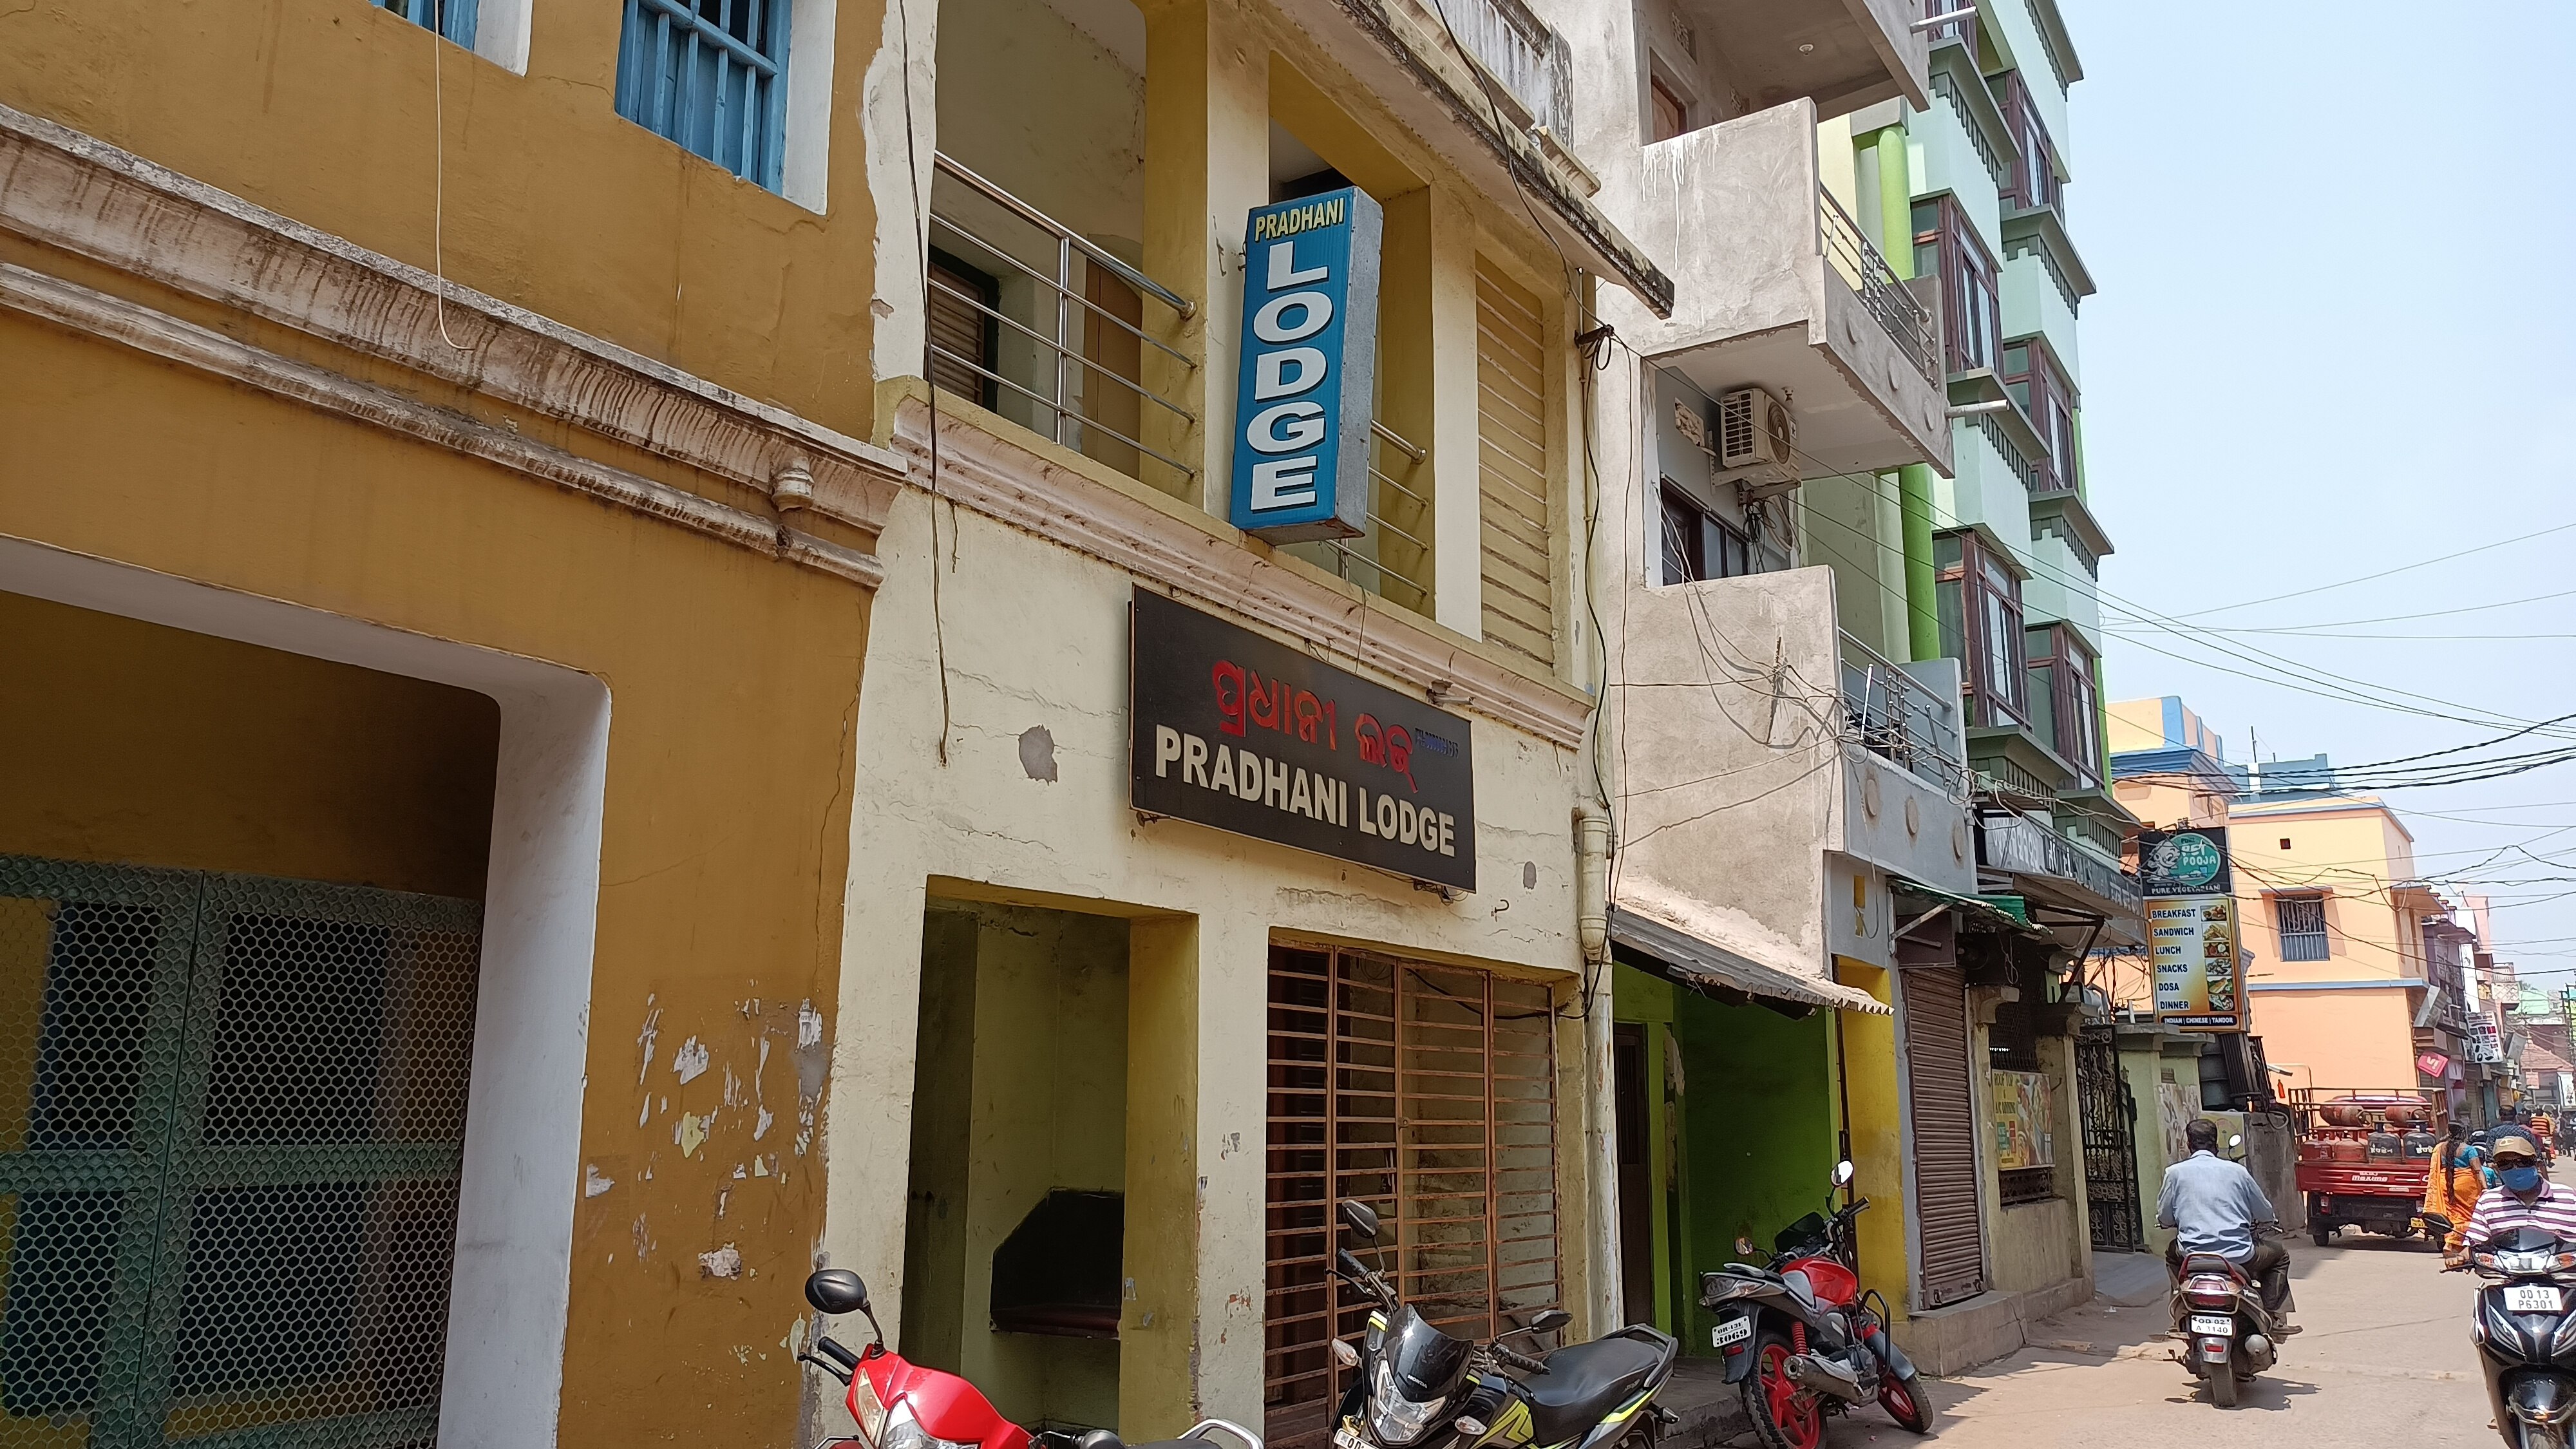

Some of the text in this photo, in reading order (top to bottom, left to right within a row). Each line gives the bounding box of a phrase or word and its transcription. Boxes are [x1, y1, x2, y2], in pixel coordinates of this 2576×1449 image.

[1255, 196, 1345, 242] PRADHANI
[1246, 240, 1334, 512] LODGE
[1155, 723, 1456, 858] PRADHANI LODGE
[2183, 855, 2217, 866] POOJA
[2152, 909, 2196, 918] BREAKFAST
[2154, 927, 2195, 936] SANDWICH
[2155, 945, 2181, 955] LUNCH
[2157, 964, 2188, 973] SNACKS
[2158, 983, 2179, 991] DOSA
[2160, 1001, 2189, 1010] DINNER
[2537, 1290, 2550, 1299] 13
[2519, 1300, 2553, 1309] P6301
[1408, 1374, 1428, 1389] HONDA
